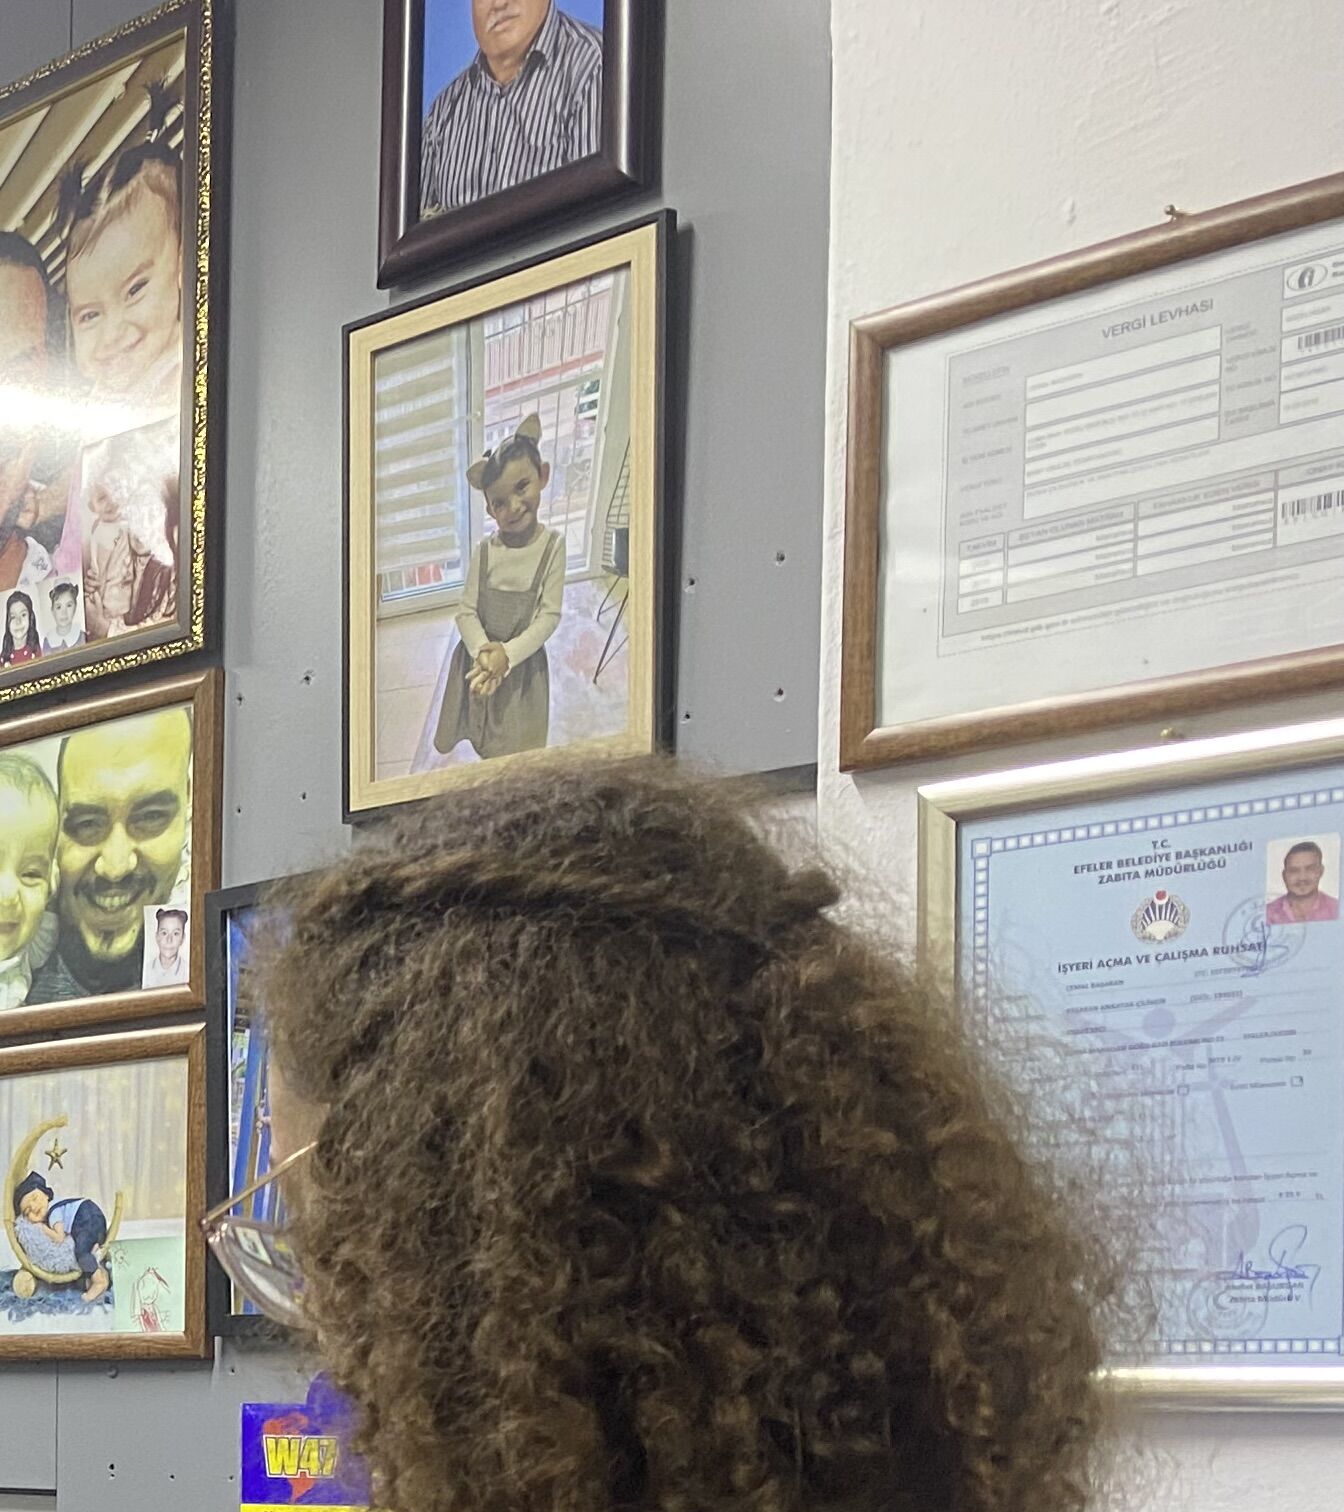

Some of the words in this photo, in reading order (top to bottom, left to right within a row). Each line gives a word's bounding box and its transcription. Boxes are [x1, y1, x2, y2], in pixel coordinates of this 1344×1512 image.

[1073, 860, 1113, 875] EFELER
[1117, 851, 1172, 869] BELEDİYE
[1175, 840, 1253, 861] BAŞKANLIĞI
[1151, 840, 1172, 850] T.C.
[1098, 871, 1141, 885] ZABITA
[1144, 858, 1227, 880] MÜDÜRLÜĞÜ
[1057, 960, 1093, 974] İŞYERİ
[1098, 956, 1132, 969] AÇMA
[1136, 953, 1151, 964] VE
[1155, 947, 1209, 963] ÇALIŞMA
[262, 1434, 340, 1478] W47
